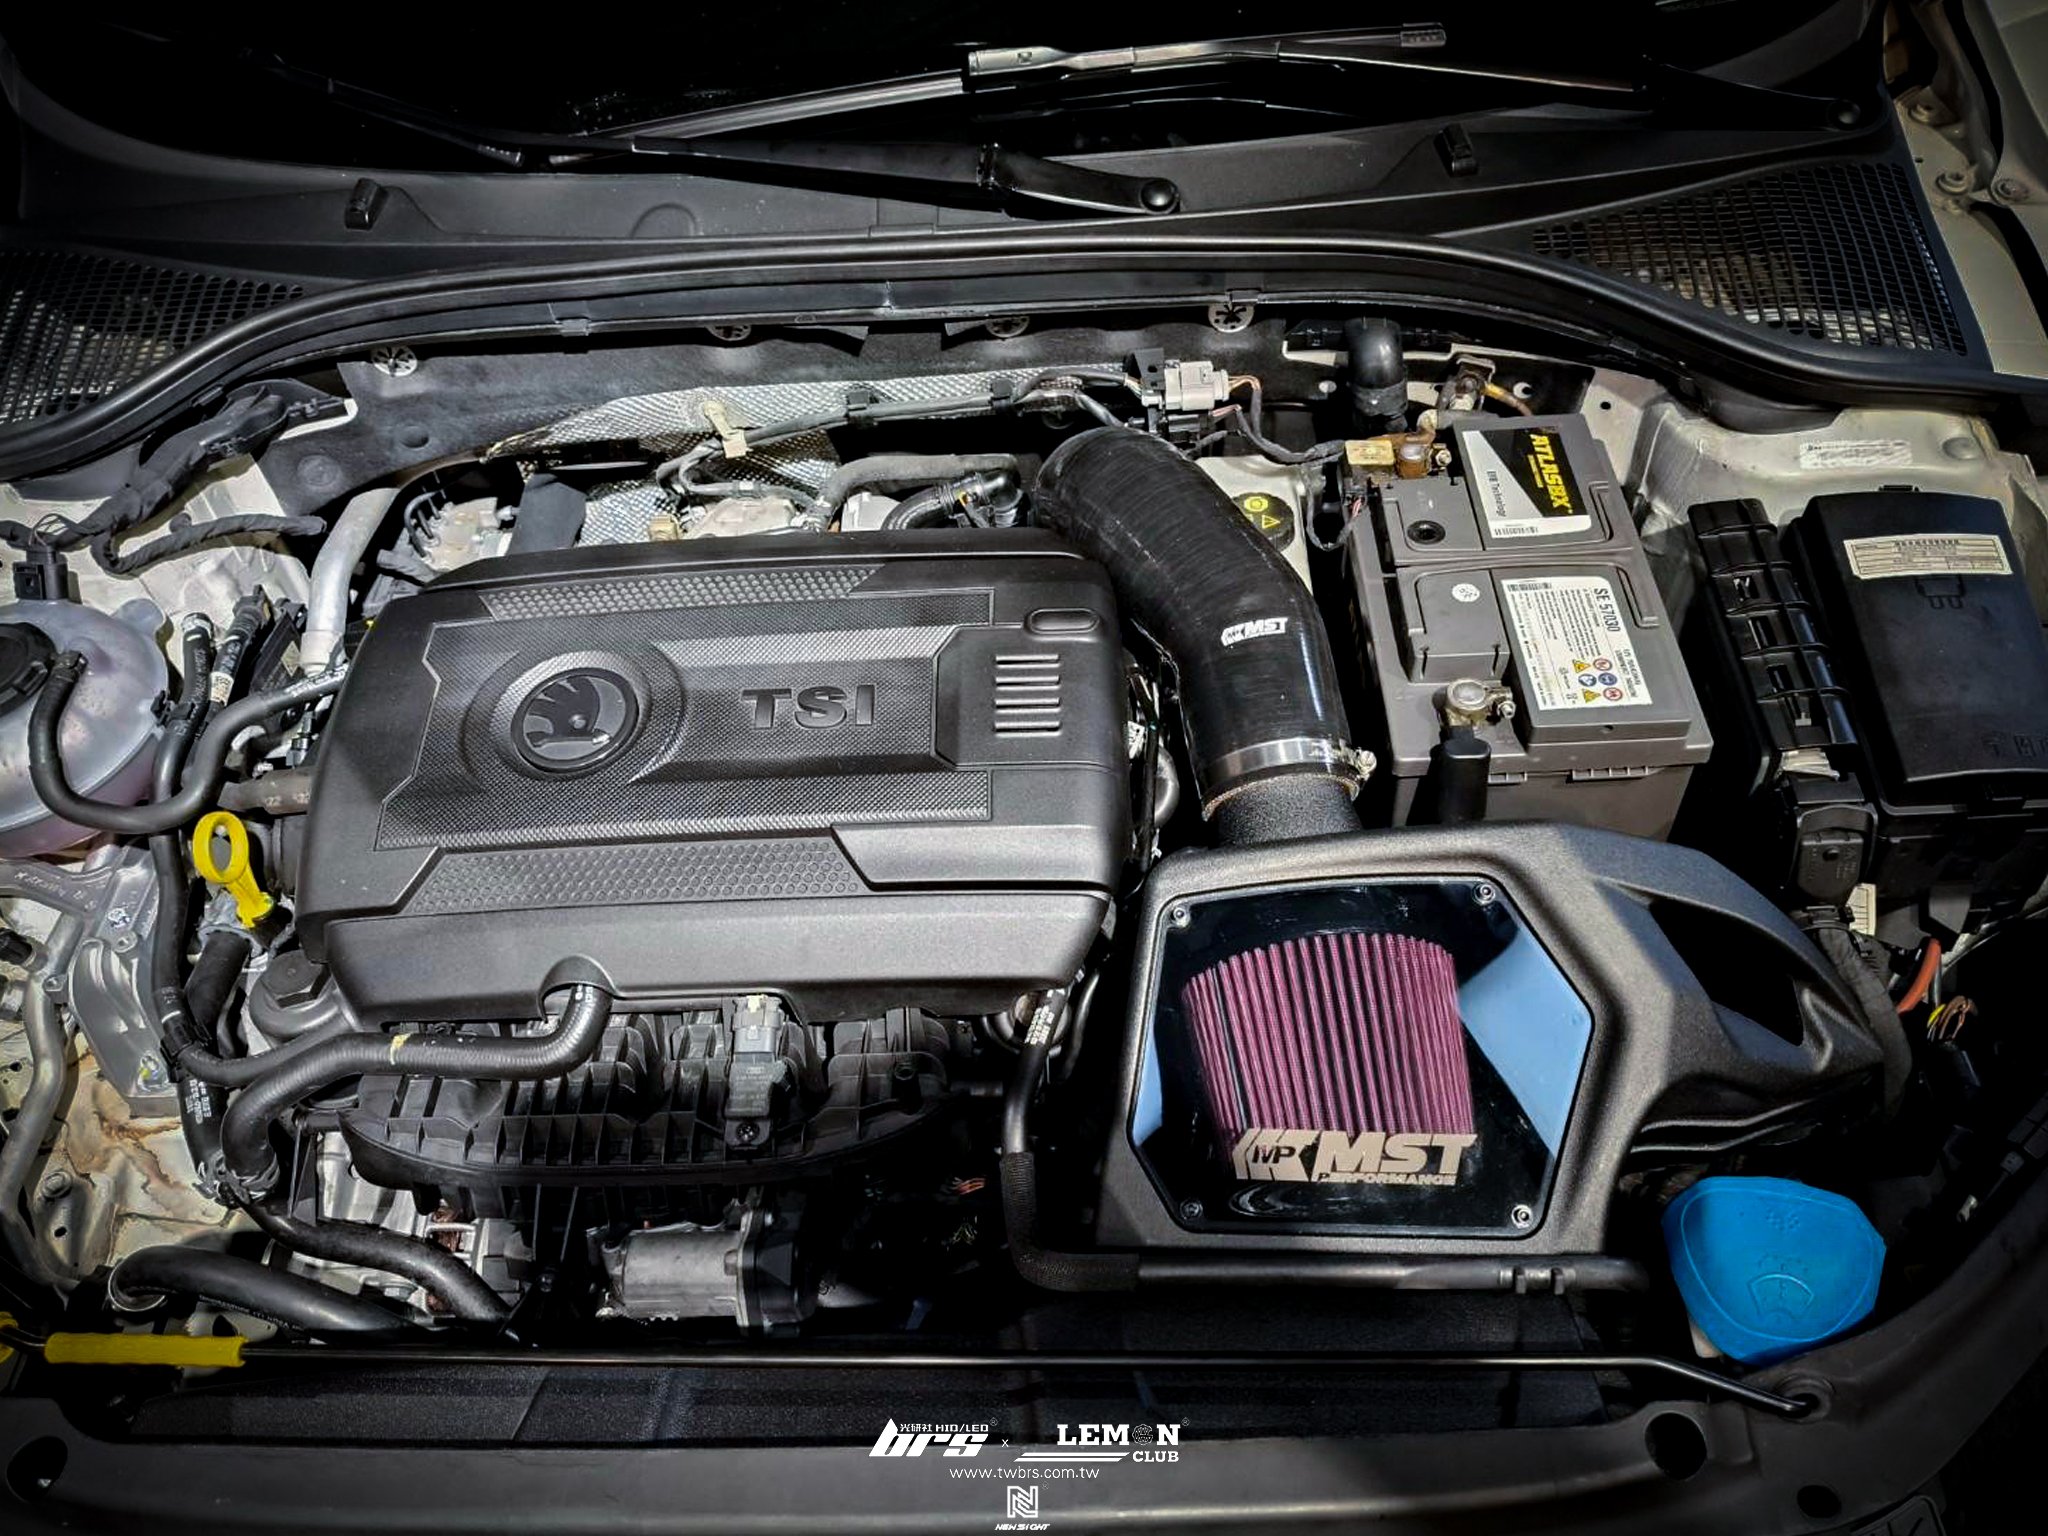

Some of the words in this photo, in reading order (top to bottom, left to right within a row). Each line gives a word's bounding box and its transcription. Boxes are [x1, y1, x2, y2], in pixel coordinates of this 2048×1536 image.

[1530, 434, 1571, 509] ATLASBX
[1594, 588, 1611, 602] SE
[1245, 617, 1289, 637] MST
[1600, 604, 1621, 632] 57030
[741, 684, 876, 729] TSI
[1312, 1130, 1478, 1174] MST
